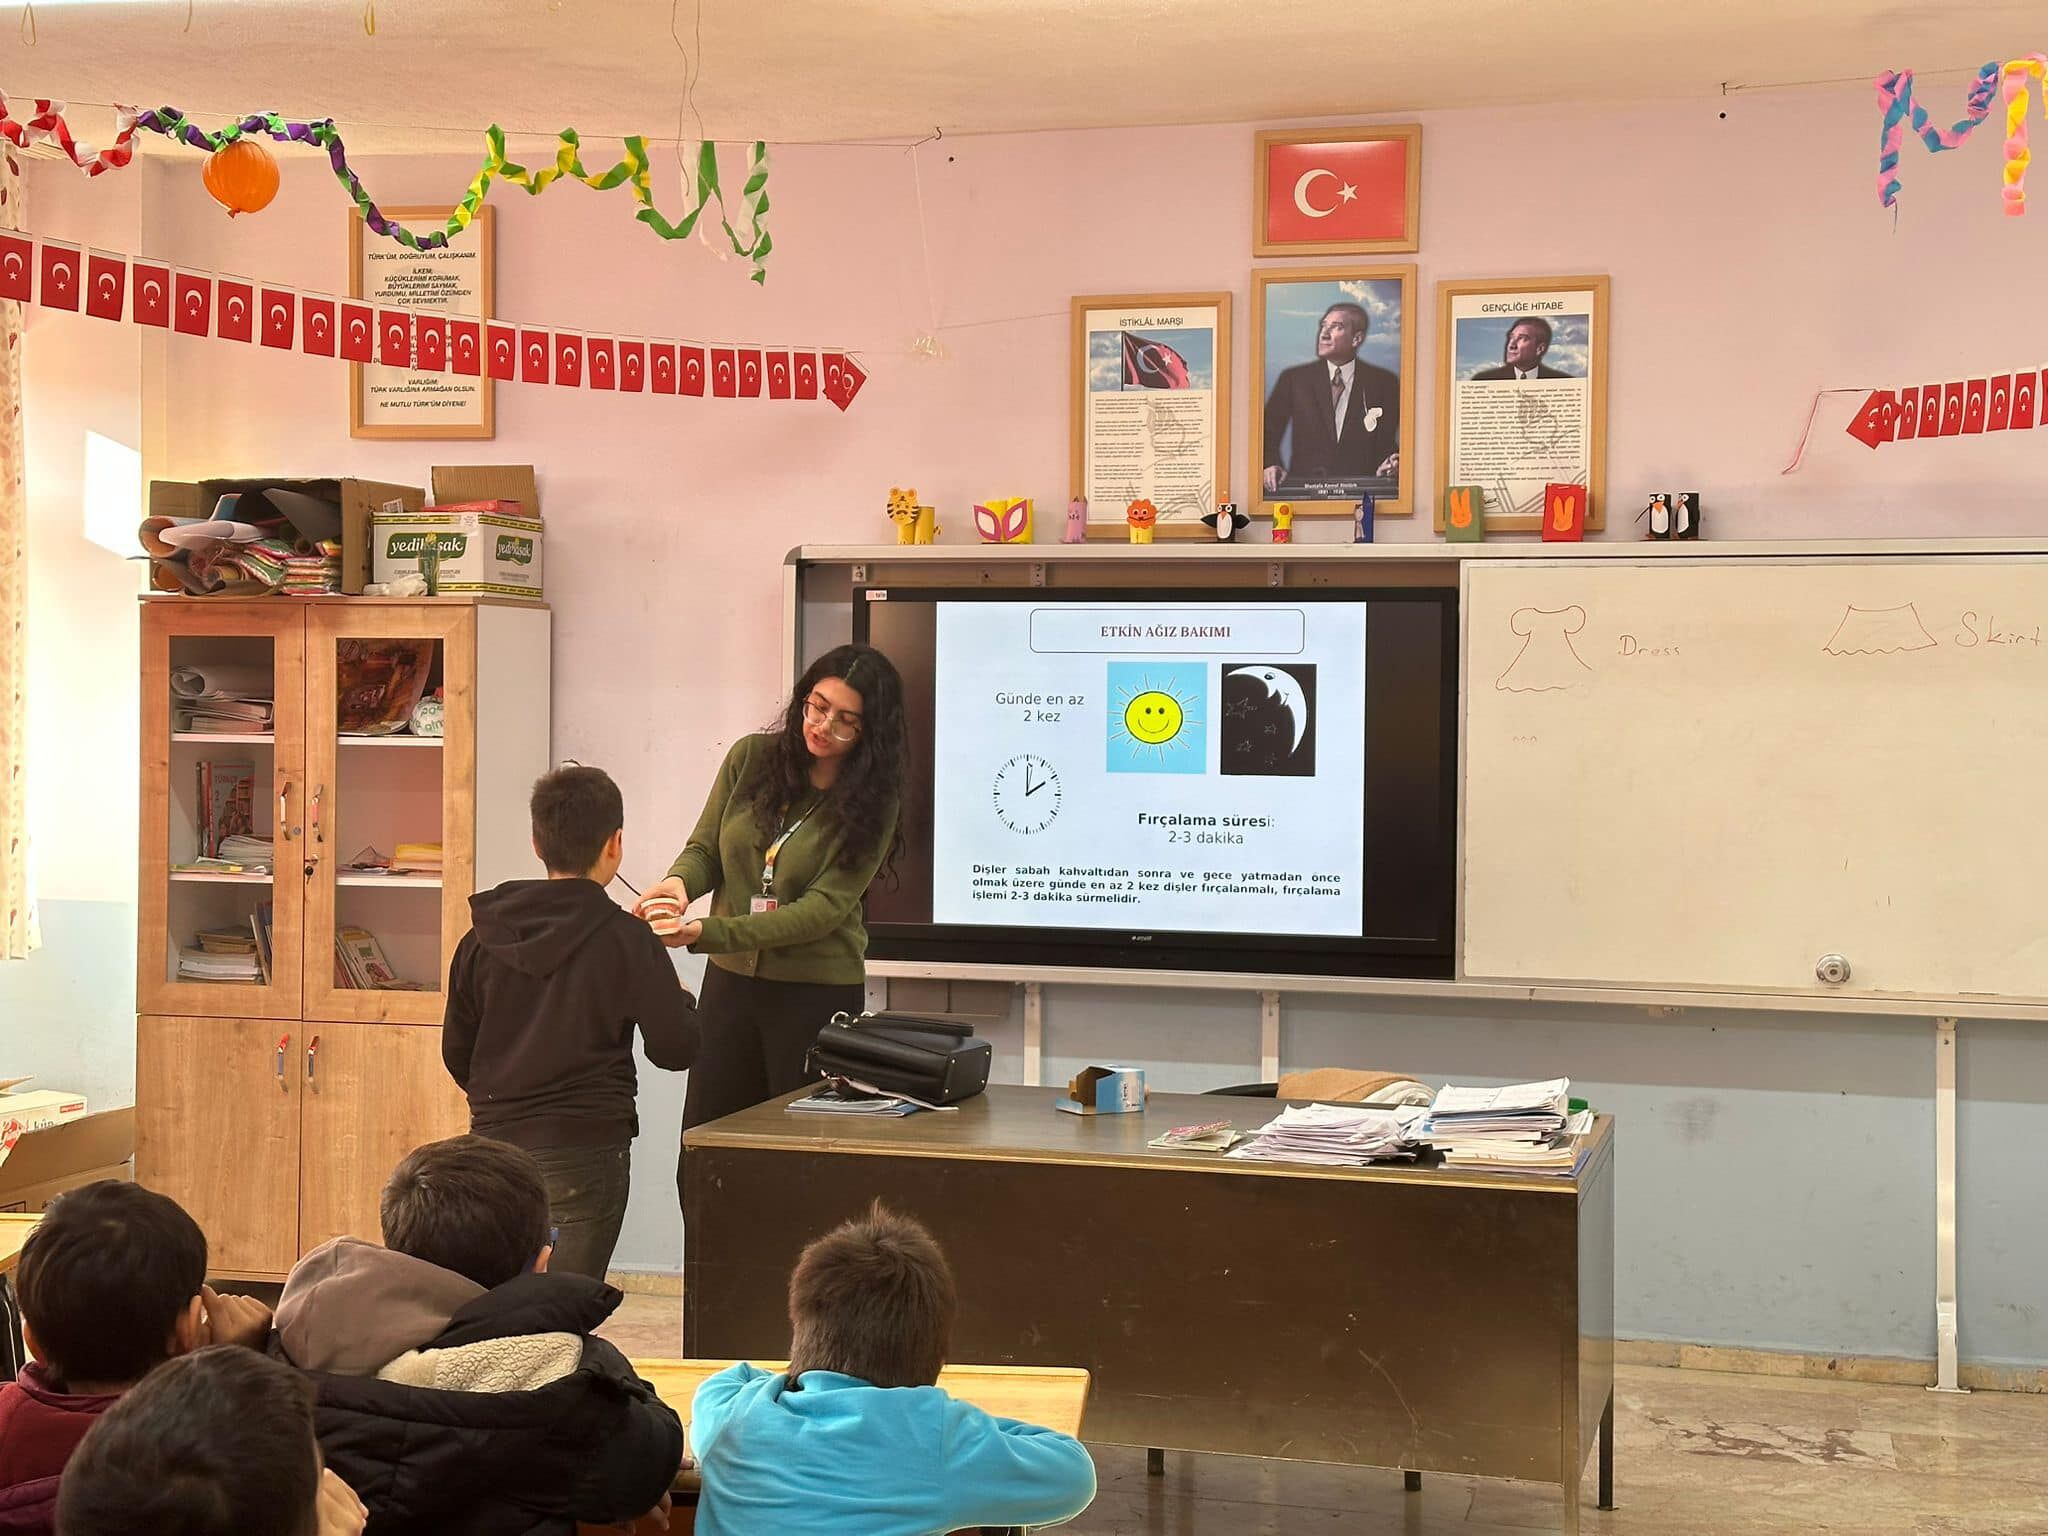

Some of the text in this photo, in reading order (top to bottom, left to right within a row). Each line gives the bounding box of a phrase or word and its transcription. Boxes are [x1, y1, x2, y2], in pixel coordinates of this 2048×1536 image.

[1482, 302, 1563, 313] GENÇLİĞE HİTABE
[1156, 318, 1183, 326] MARŞI
[1101, 624, 1230, 637] ETKİN AĞIZ BAKIMI
[1619, 633, 1681, 657] Dress
[996, 693, 1084, 705] Günde en az
[1024, 710, 1060, 722] 2 kez
[1139, 813, 1274, 828] Fırçalama süresi:
[1169, 831, 1243, 844] 2-3 dakika
[1016, 866, 1050, 875] sabah
[1060, 866, 1128, 877] kahvaltıdan
[1138, 870, 1171, 878] sonra
[1203, 871, 1232, 881] gece
[1241, 872, 1302, 883] yatmadan
[973, 878, 1008, 888] olmak
[1013, 878, 1044, 888] üzere
[1049, 879, 1086, 892] günde
[1127, 881, 1133, 891] 2
[1139, 882, 1159, 891] kez
[1164, 882, 1197, 893] dişler
[1202, 883, 1277, 895] fırçalanmalı,
[1283, 885, 1340, 897] fırçalama
[973, 891, 1140, 903] işlemi 2-3 dakika sürmelidir.
